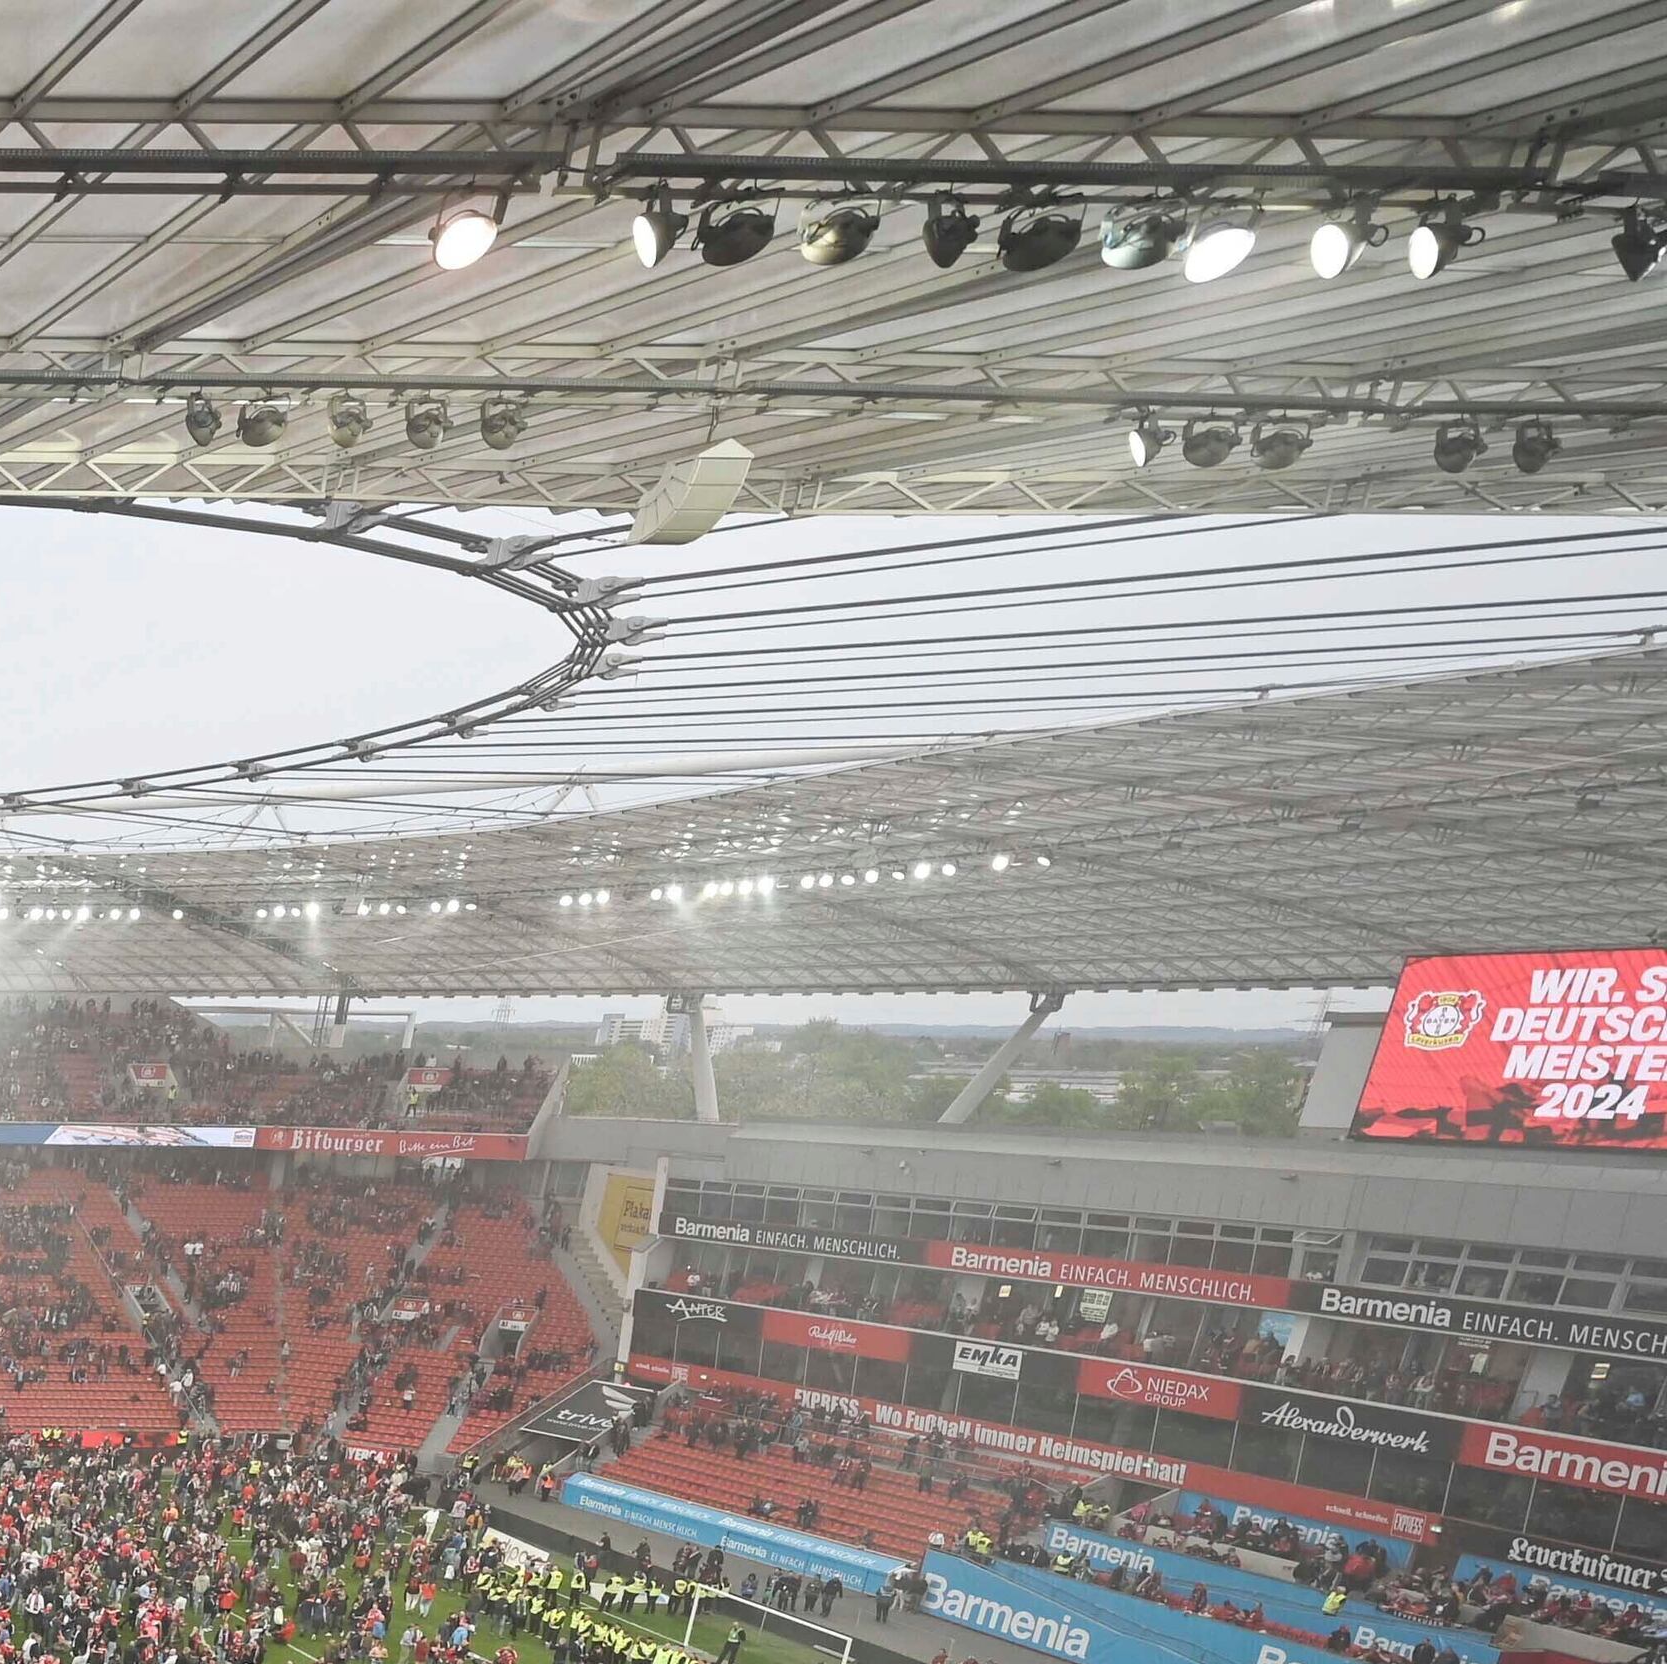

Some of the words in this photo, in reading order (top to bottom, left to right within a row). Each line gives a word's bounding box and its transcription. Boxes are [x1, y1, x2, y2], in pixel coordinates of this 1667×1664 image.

[1529, 967, 1625, 1004] WIR.
[1534, 1083, 1649, 1120] 2024
[290, 1129, 383, 1153] Bitburger
[675, 1217, 751, 1242] Barmenia
[756, 1230, 809, 1249] EINFACH.
[814, 1236, 901, 1260] MENSCHLICH.
[951, 1246, 1052, 1278] Barmenia
[1060, 1263, 1132, 1287] EINFACH.
[1139, 1272, 1256, 1302] MENSCHLICH.
[667, 1299, 727, 1319] ANTER
[1320, 1287, 1452, 1328] Barmenia
[1462, 1311, 1559, 1341] EINFACH.
[1145, 1392, 1186, 1408] GROUP
[1147, 1376, 1209, 1401] NIEDAX
[876, 1404, 901, 1427] Wo
[975, 1422, 1035, 1453] immer
[1040, 1434, 1144, 1475] Heimspiel
[1145, 1455, 1187, 1484] hat!
[1261, 1400, 1430, 1455] Alexanderwerk
[1395, 1513, 1426, 1535] EXPRESS
[1049, 1525, 1155, 1574] Barmenia
[921, 1572, 1092, 1660] Barmenia
